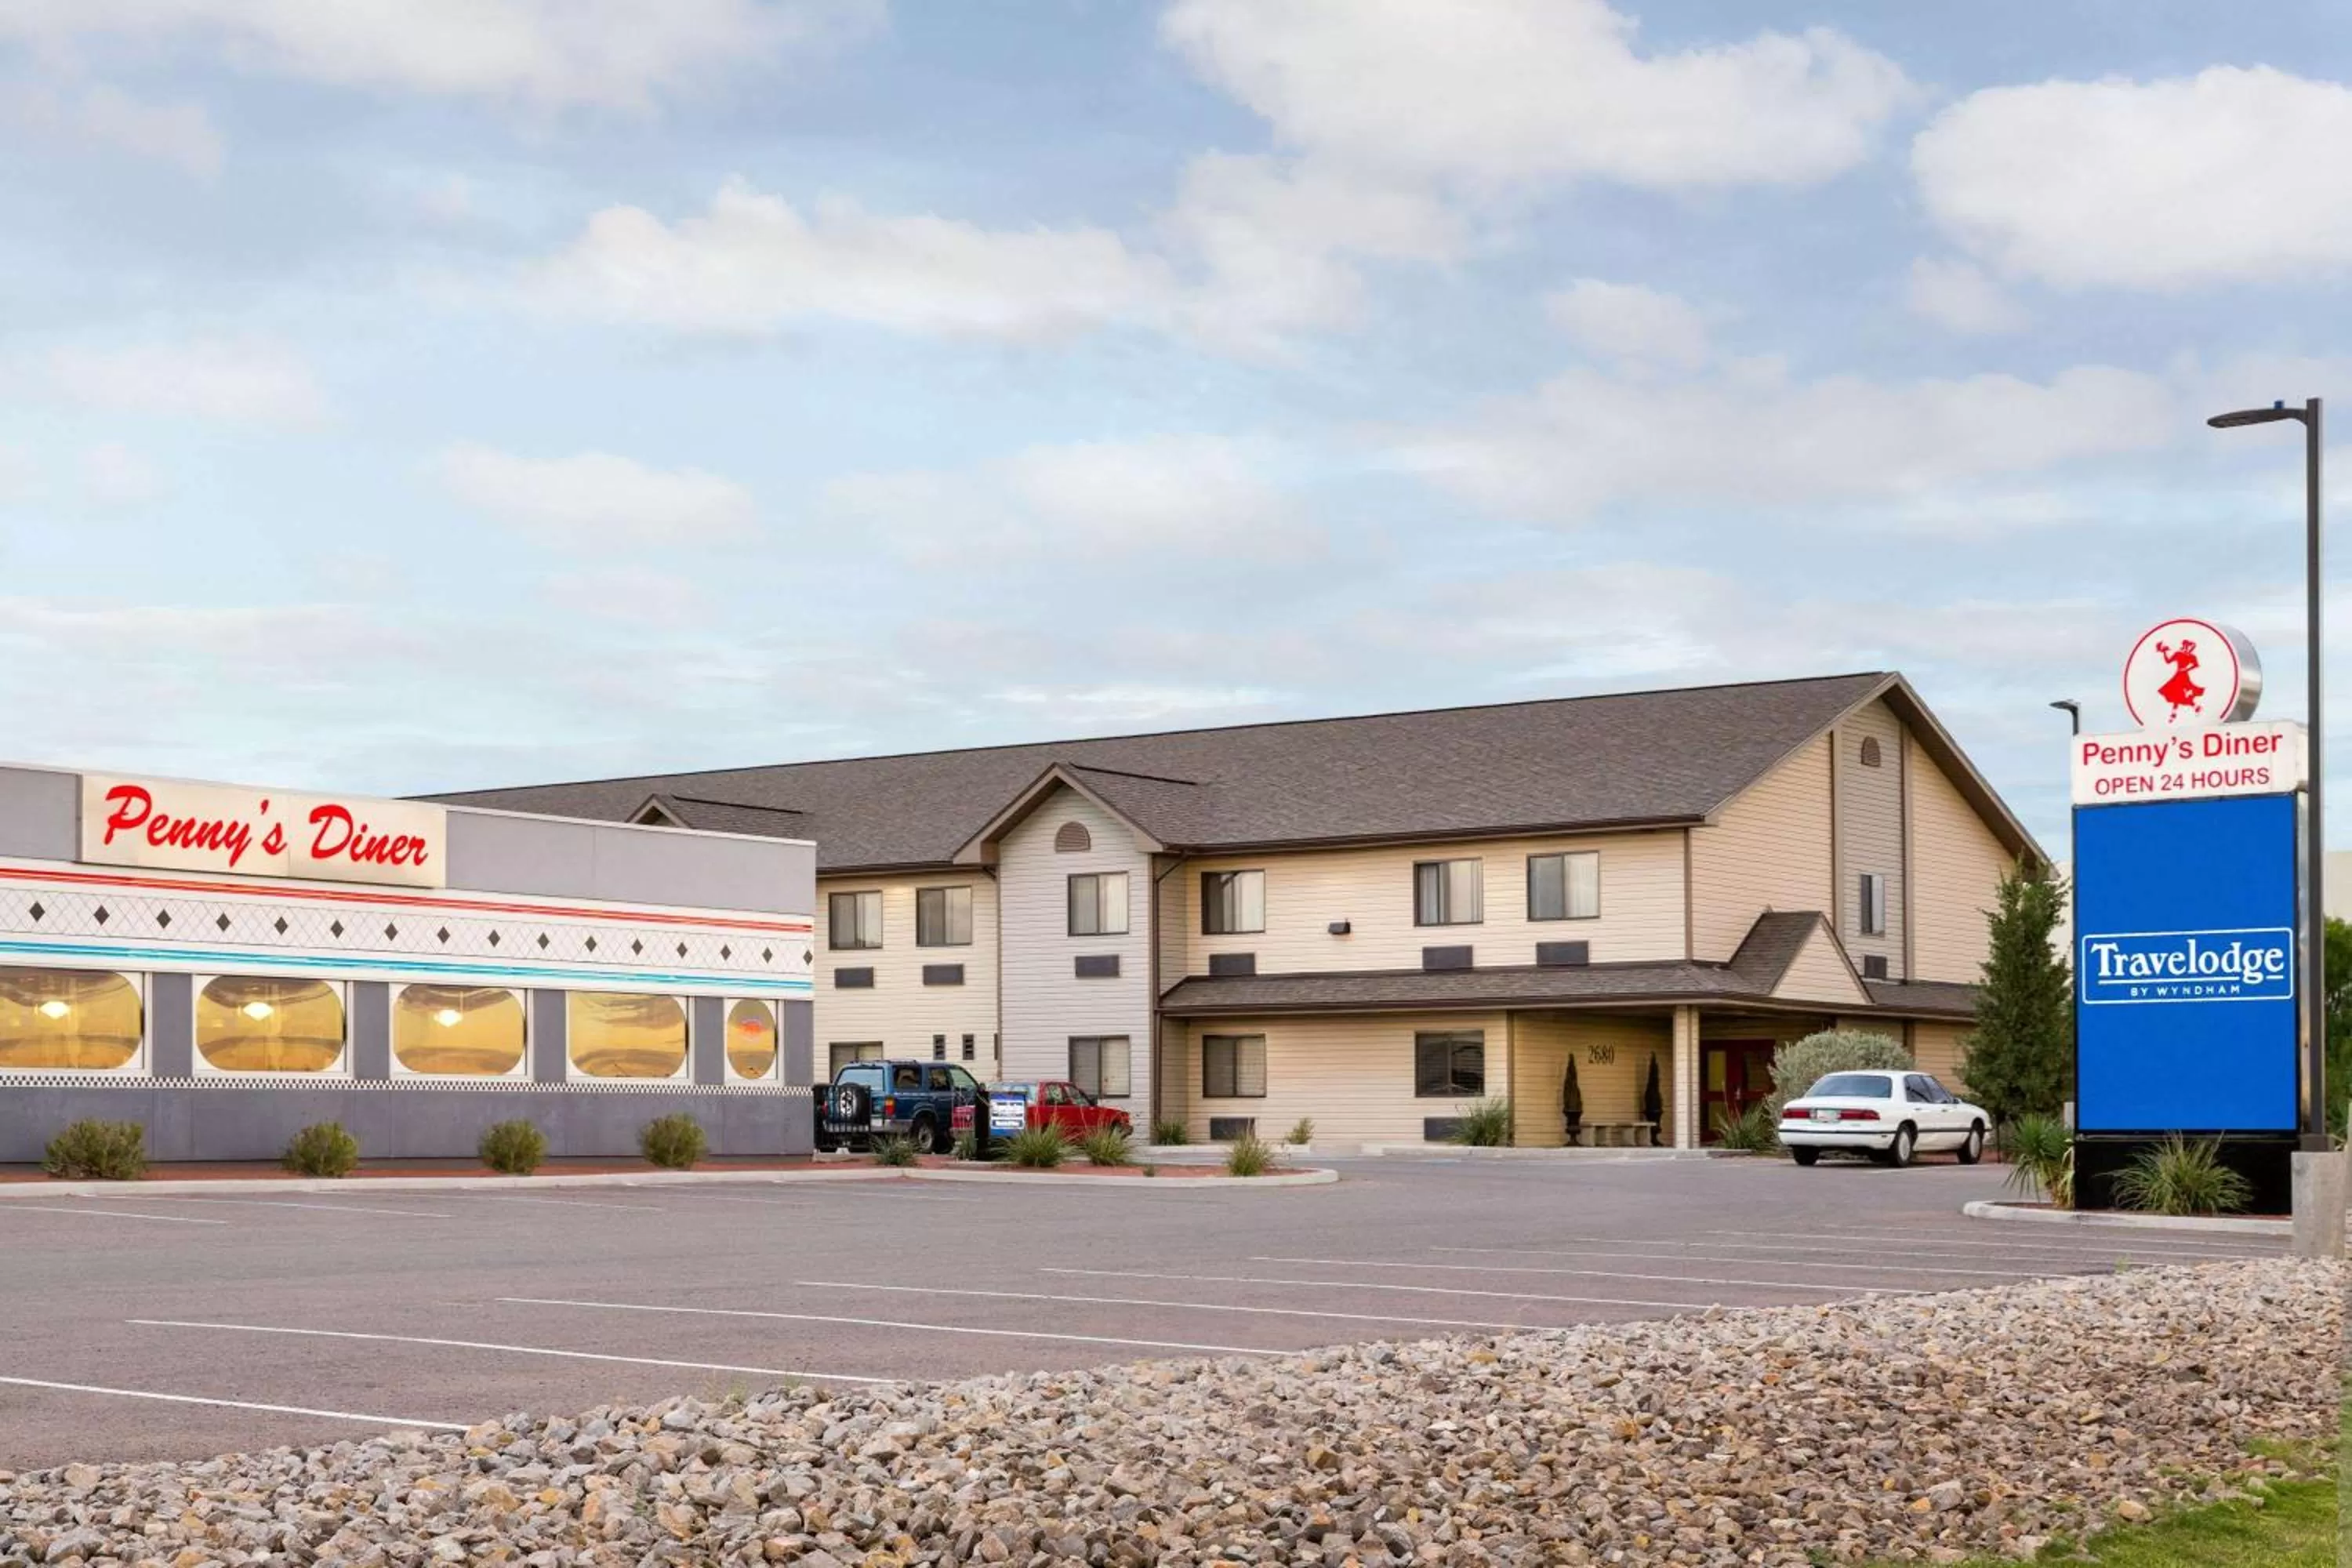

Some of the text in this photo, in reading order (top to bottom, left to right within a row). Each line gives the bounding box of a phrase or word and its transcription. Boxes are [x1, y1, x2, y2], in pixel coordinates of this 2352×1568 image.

[2082, 732, 2283, 768] Penny's Diner
[2094, 768, 2270, 795] OPEN 24 HOURS
[103, 784, 429, 867] Penny's Diner
[2091, 938, 2284, 985] Travelodge
[2130, 985, 2241, 996] BY WYNDHAM
[1588, 1044, 1615, 1064] 2680
